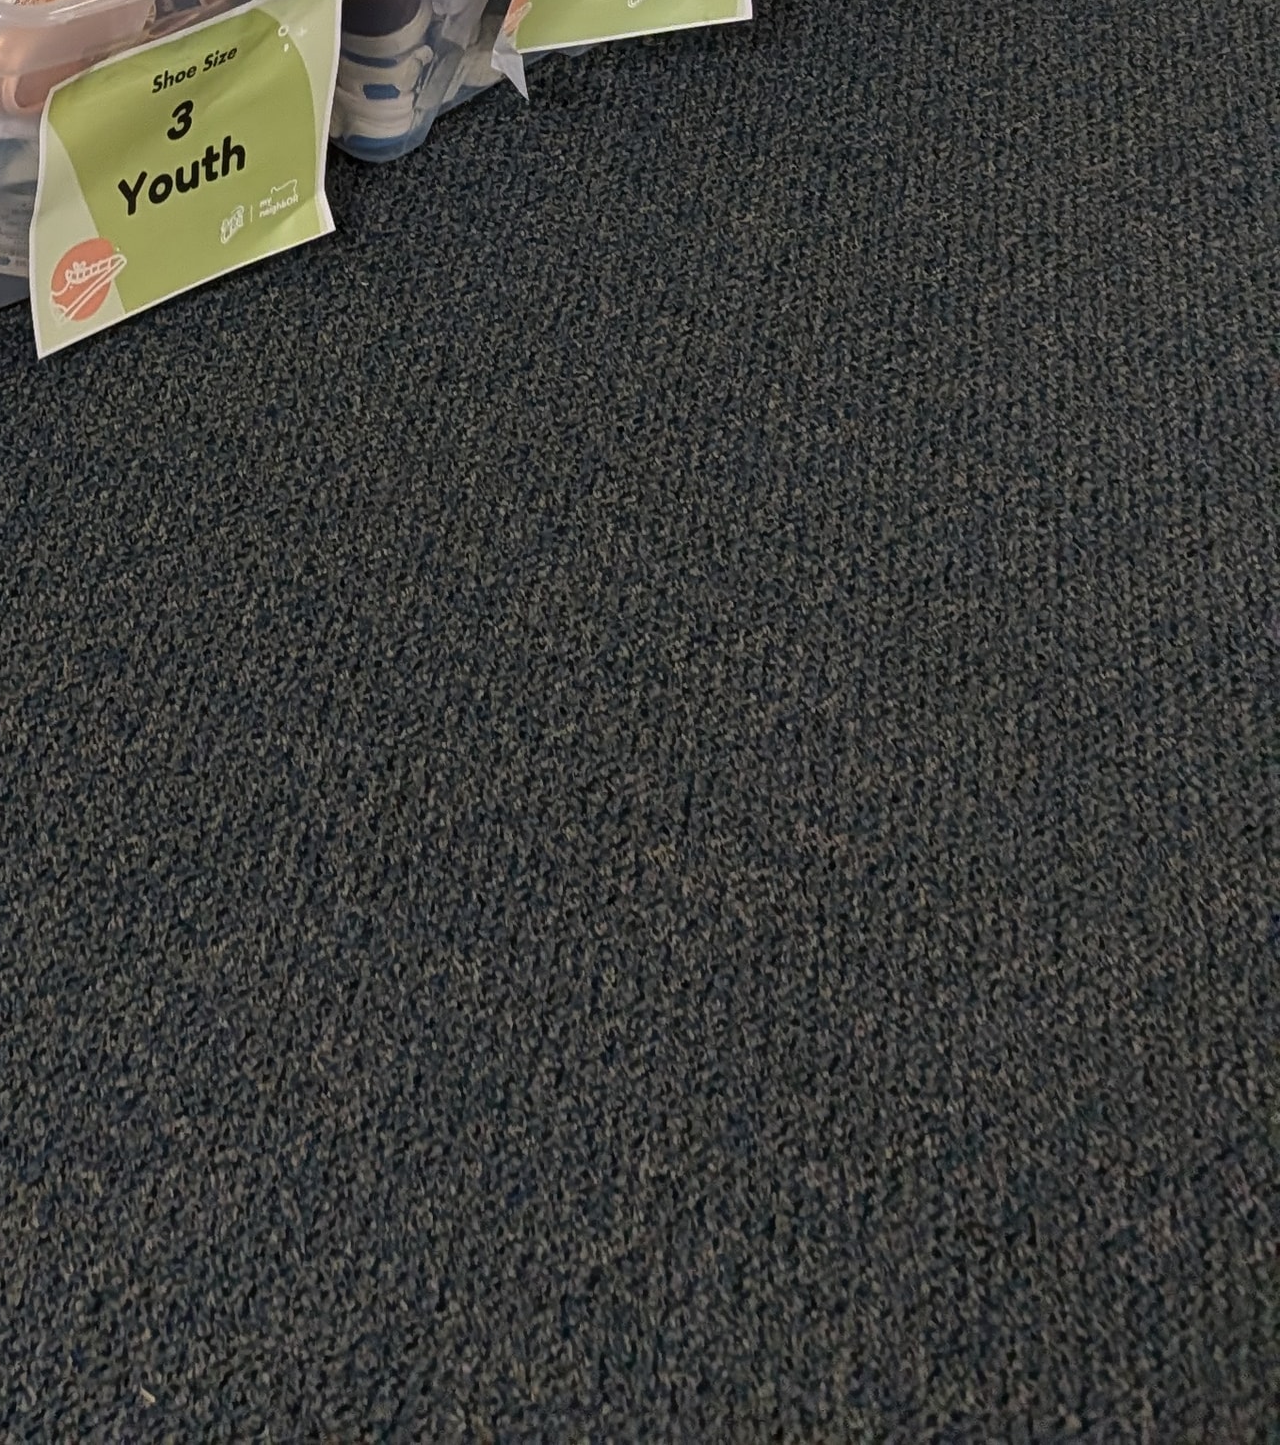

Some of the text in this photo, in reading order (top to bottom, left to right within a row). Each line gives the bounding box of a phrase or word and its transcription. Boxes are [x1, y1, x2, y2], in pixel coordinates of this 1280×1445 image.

[151, 48, 237, 93] Shoe Size
[167, 100, 194, 140] 3
[118, 136, 246, 216] Youth
